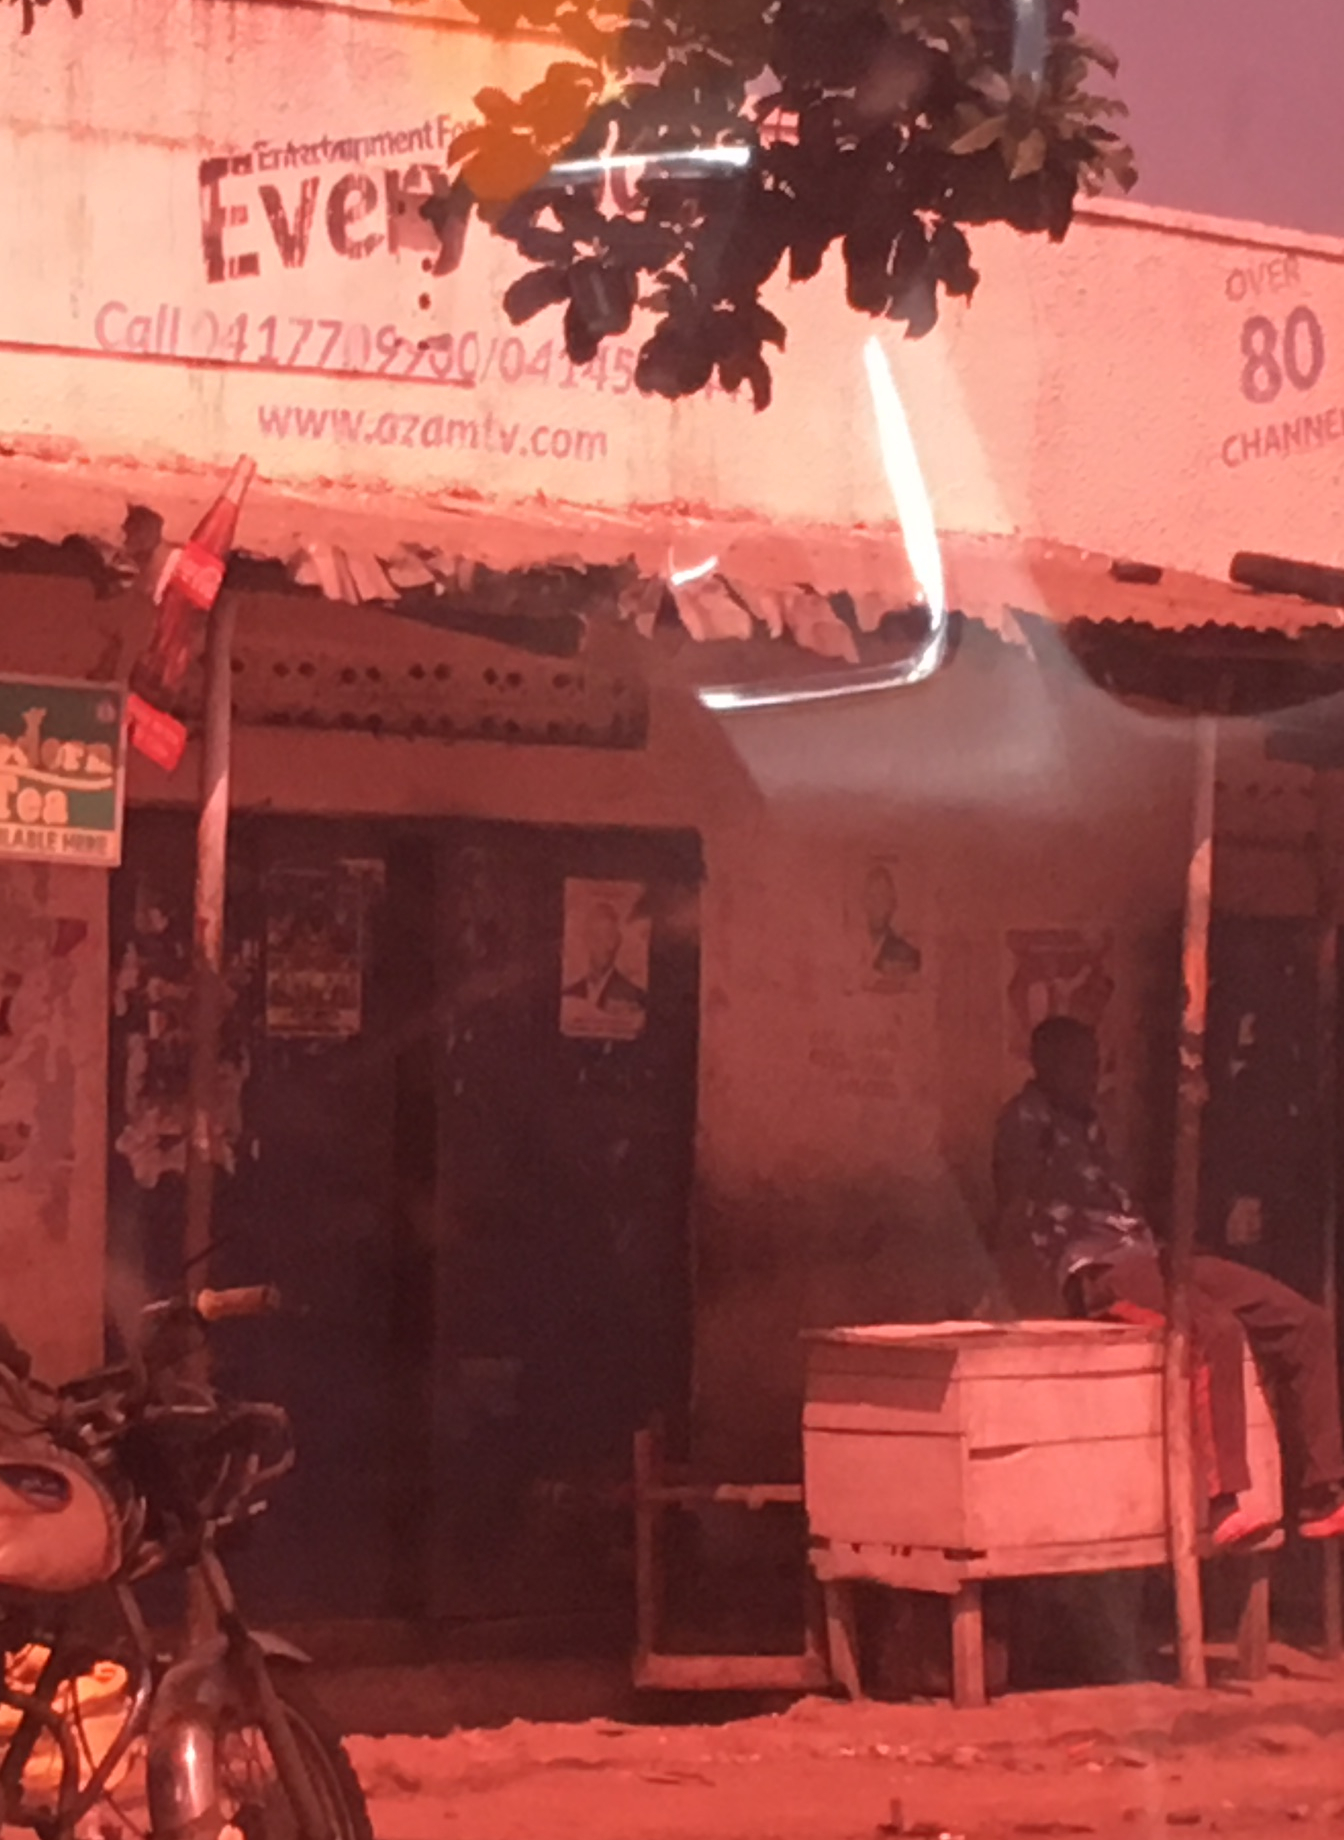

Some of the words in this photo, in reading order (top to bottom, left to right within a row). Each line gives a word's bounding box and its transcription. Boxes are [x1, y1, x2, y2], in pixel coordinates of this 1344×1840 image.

[1224, 251, 1301, 302] OVER
[95, 300, 180, 354] Call
[1239, 305, 1326, 404] 80
[257, 403, 609, 463] www.azamtv.com
